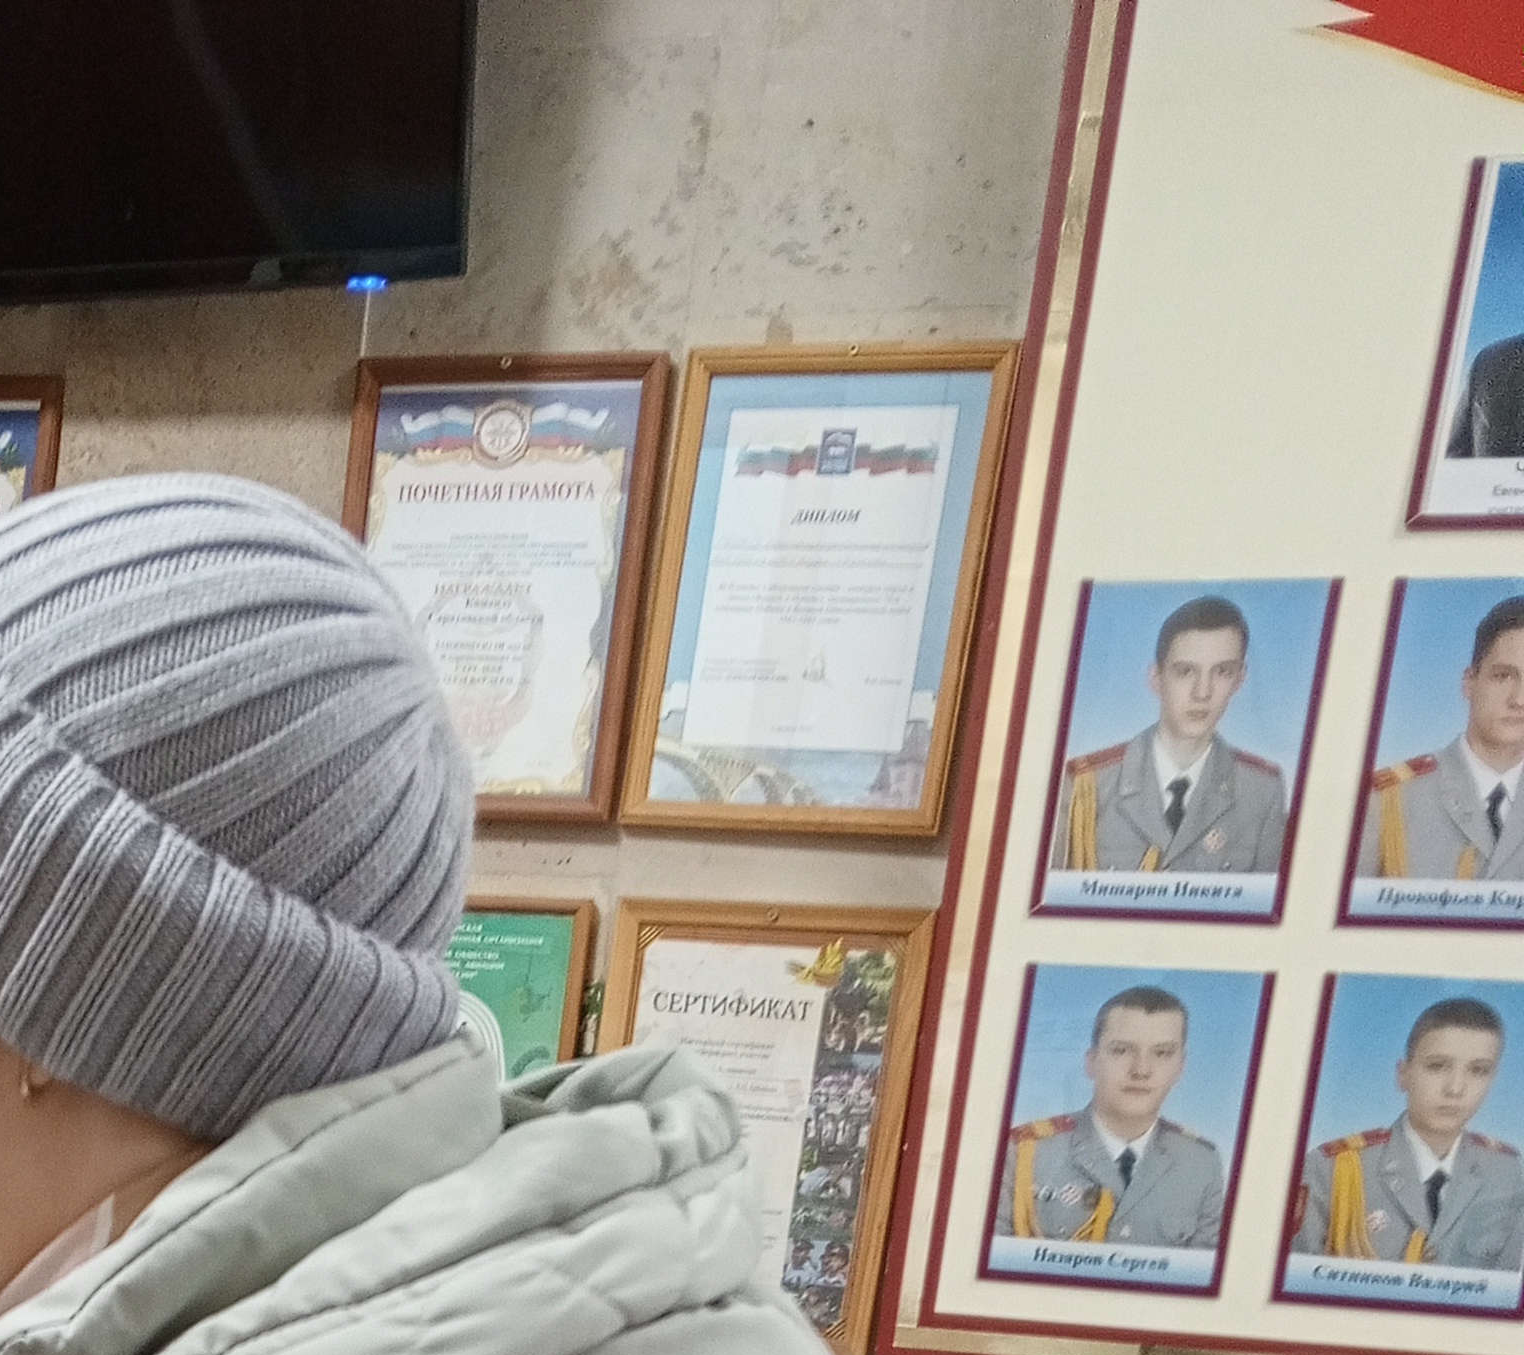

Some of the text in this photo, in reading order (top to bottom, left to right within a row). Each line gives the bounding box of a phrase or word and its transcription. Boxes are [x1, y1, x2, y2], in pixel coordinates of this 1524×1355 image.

[398, 481, 595, 503] ПОЧЕТНАЯ ГРАМОТА
[791, 509, 862, 525] ДИПЛОМ
[1080, 879, 1243, 900] Мишарин Никита
[653, 991, 813, 1021] СЕРТИФИКАТ
[1032, 1247, 1170, 1272] Назаров Сергей
